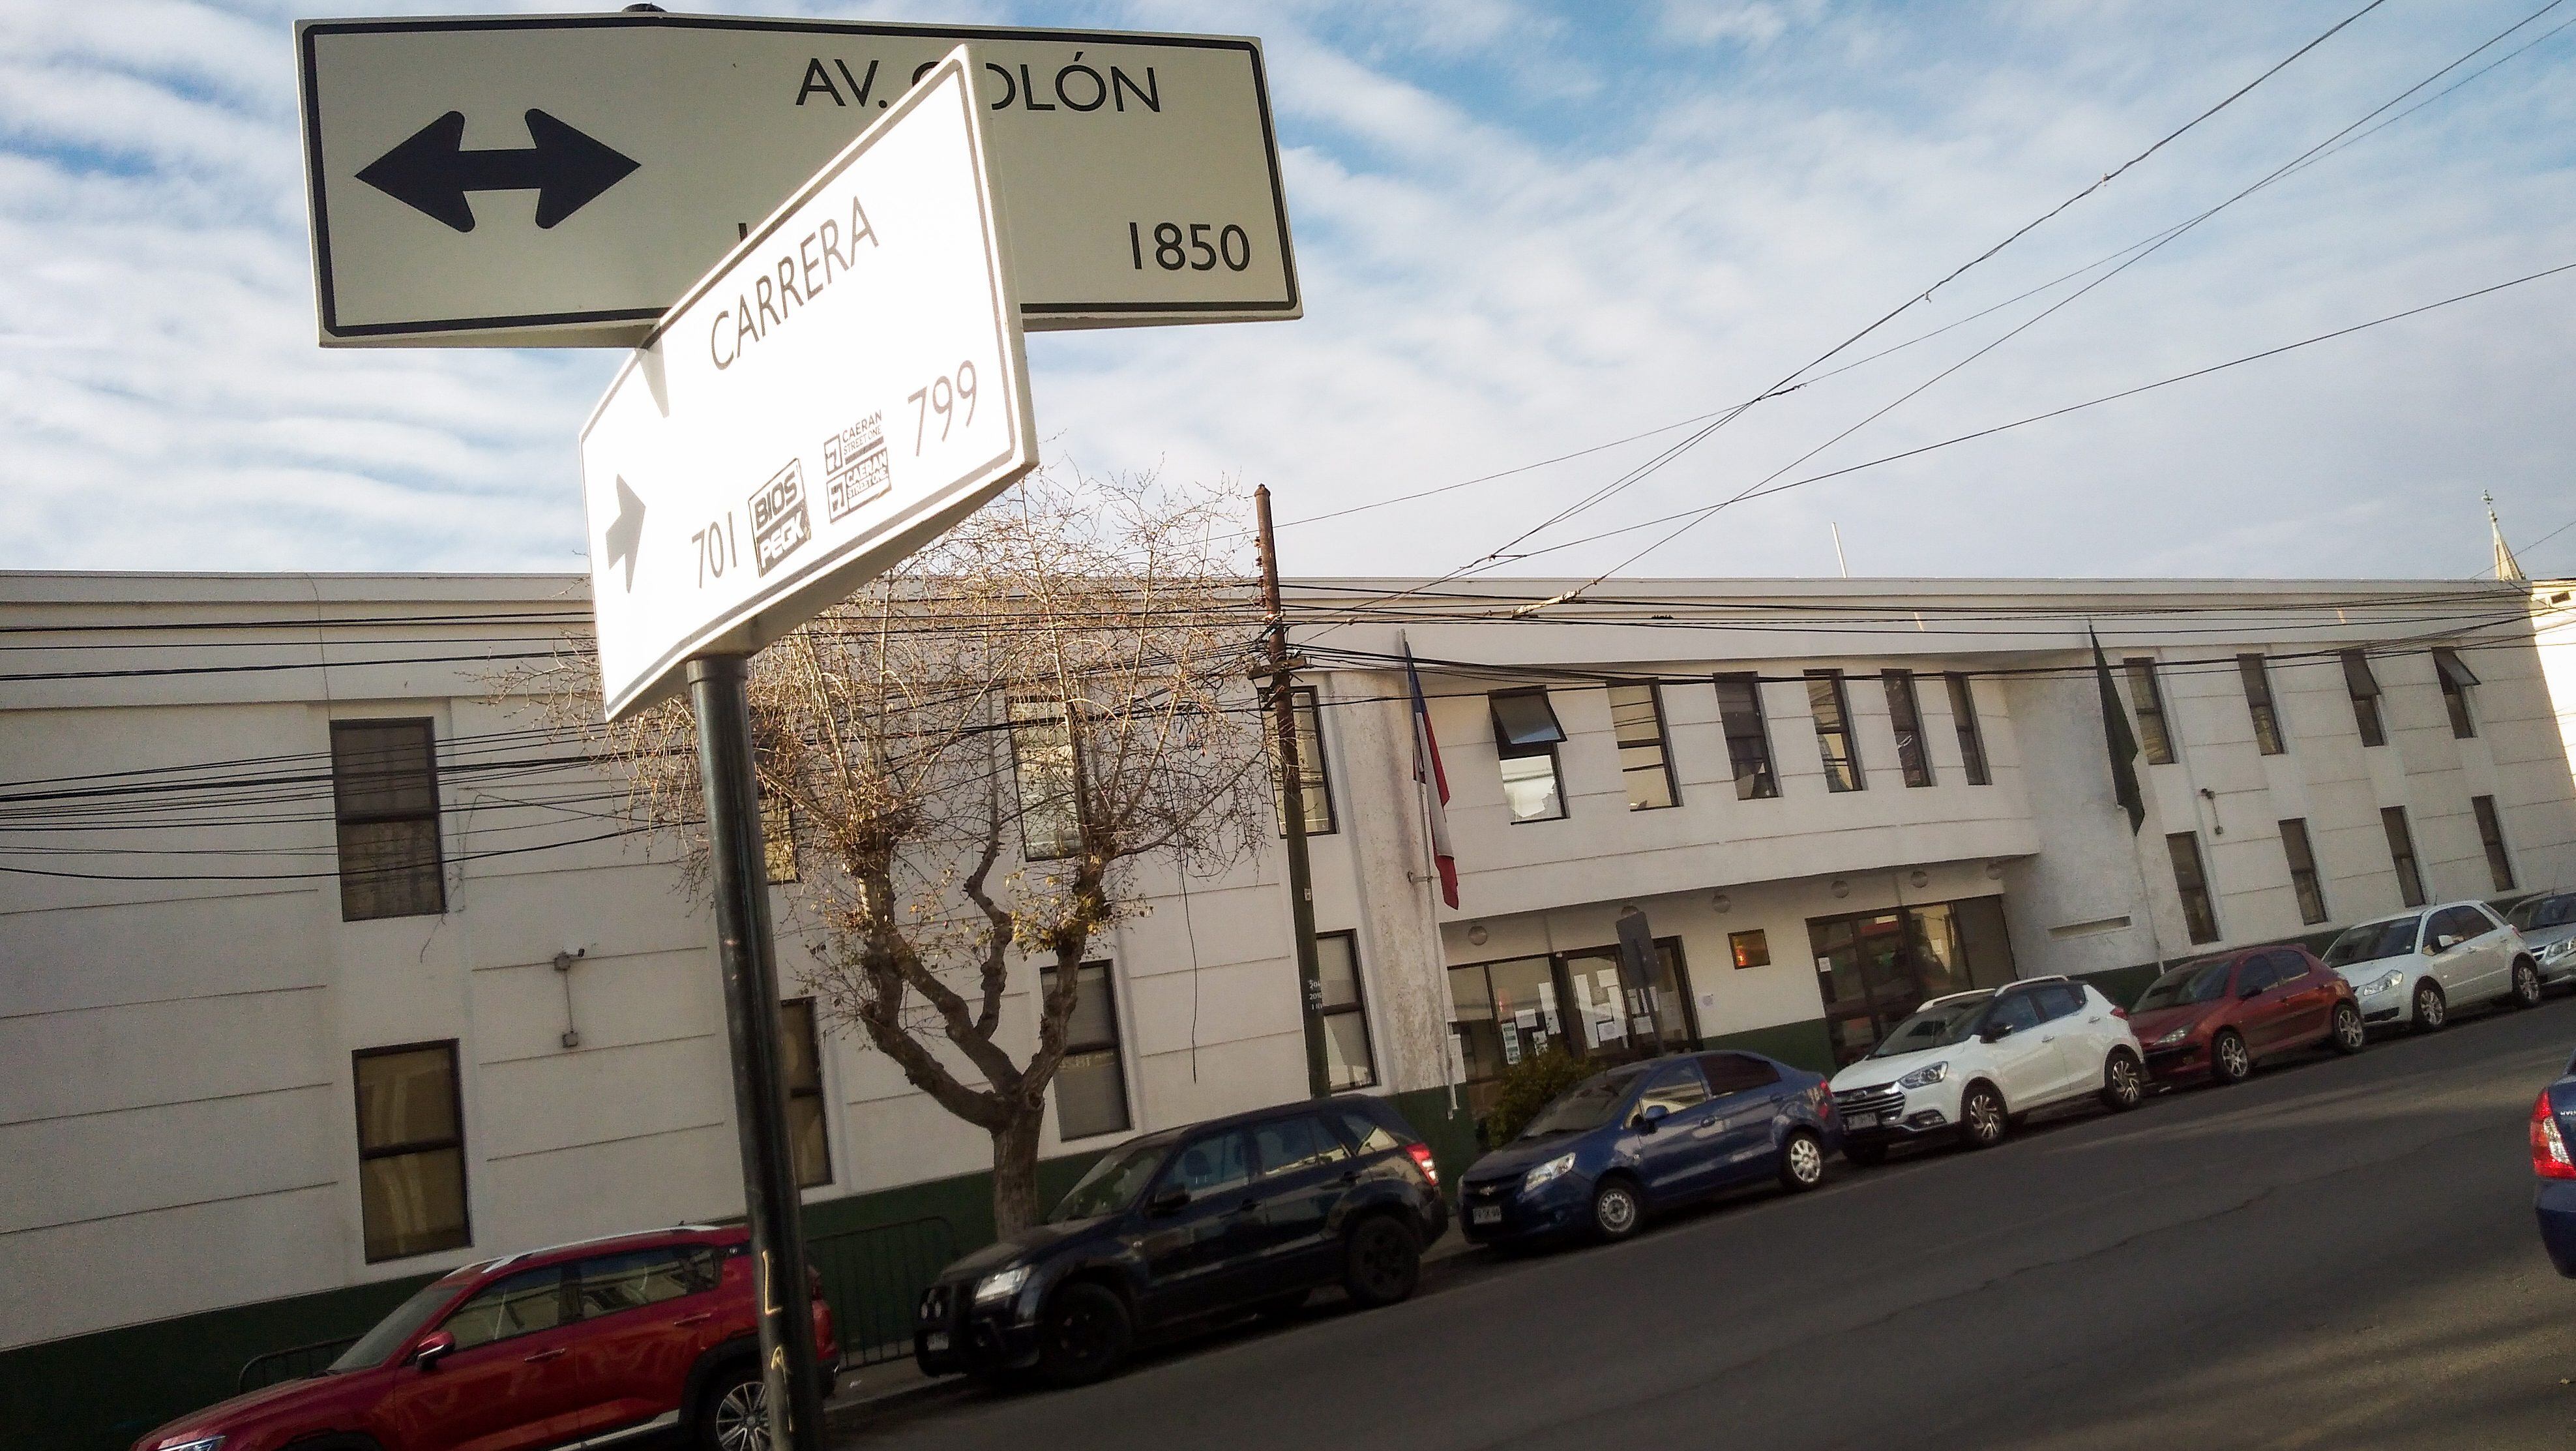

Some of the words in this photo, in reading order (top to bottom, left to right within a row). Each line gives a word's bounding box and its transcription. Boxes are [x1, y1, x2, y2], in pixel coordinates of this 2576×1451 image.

[795, 57, 888, 109] AV.
[1129, 221, 1251, 272] 1850
[711, 196, 879, 370] CARRERA
[842, 409, 882, 443] CAERAN
[908, 359, 977, 457] 799
[844, 433, 867, 455] STREET
[868, 425, 882, 440] ONE
[847, 451, 887, 486] CAERAN
[754, 470, 797, 531] BIOS
[692, 511, 737, 589] 701
